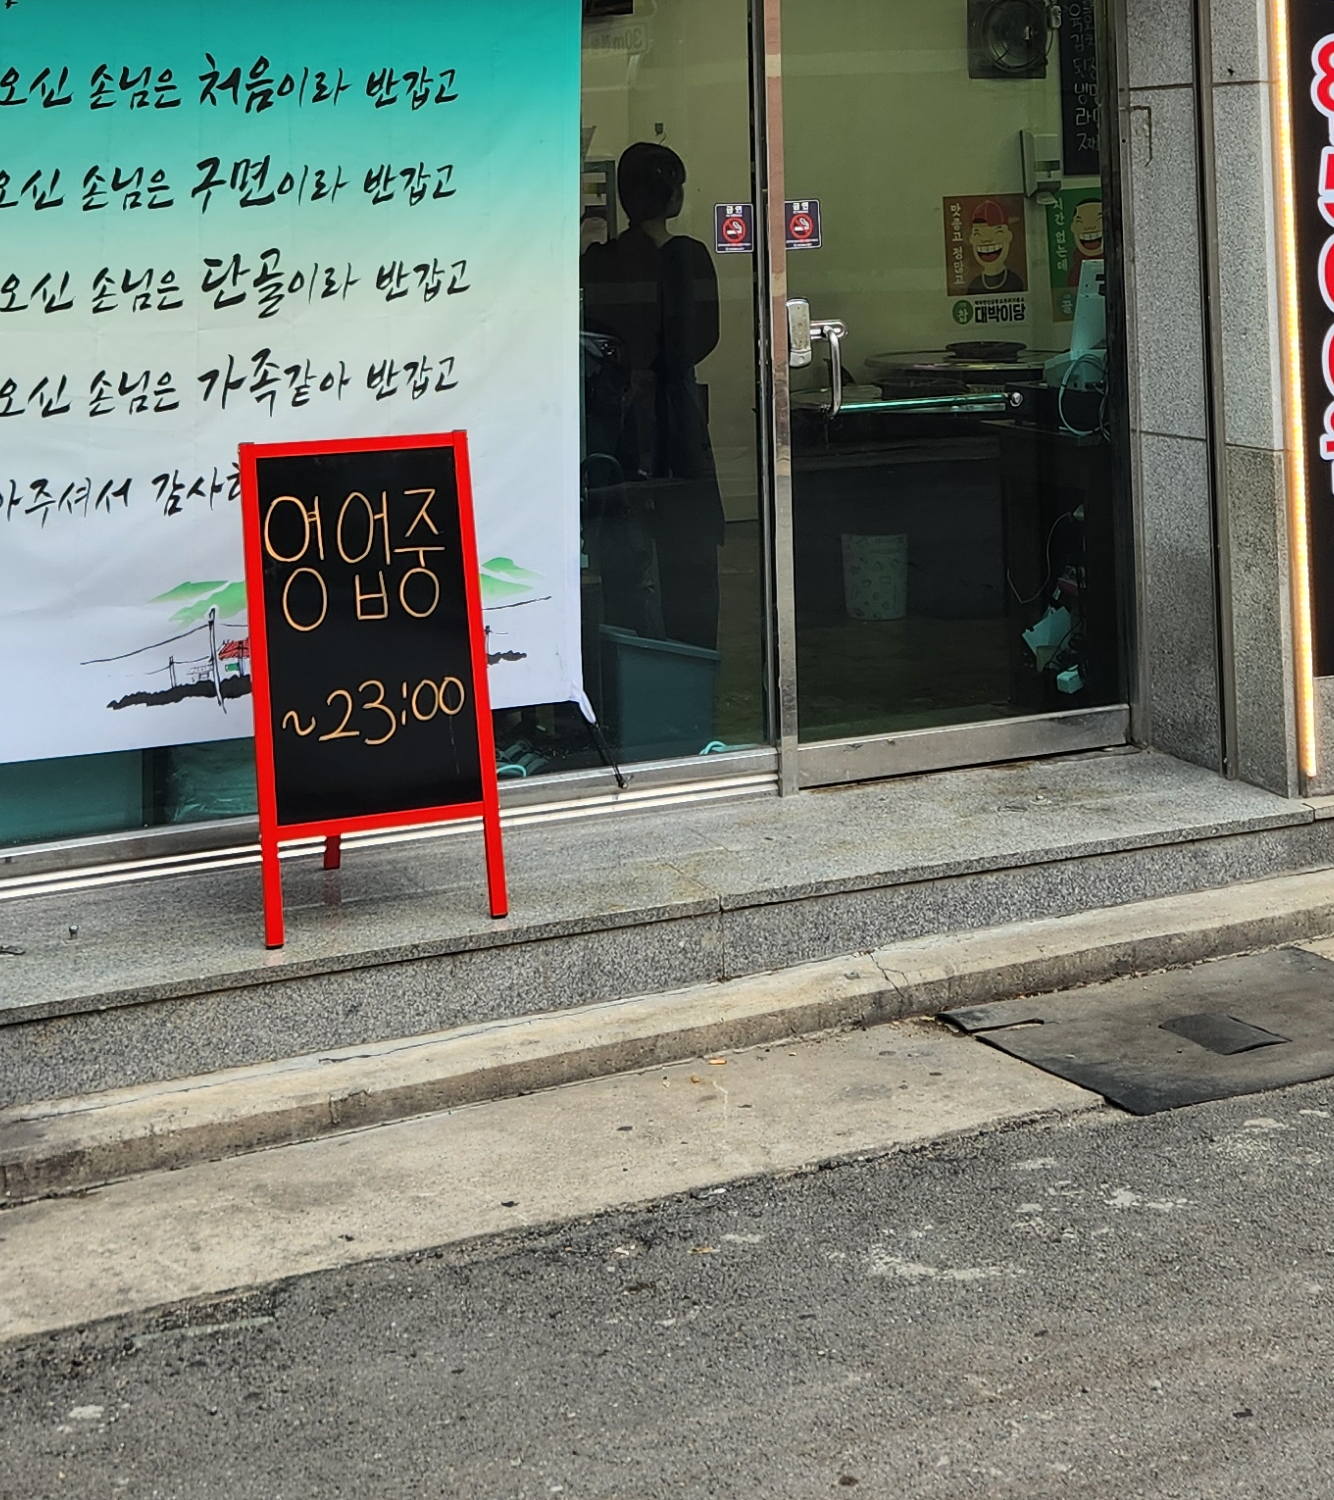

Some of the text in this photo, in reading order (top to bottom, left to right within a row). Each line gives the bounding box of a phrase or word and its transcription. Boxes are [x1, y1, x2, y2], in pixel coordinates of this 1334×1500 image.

[90, 64, 181, 109] 손님은
[199, 53, 350, 113] 처음이라
[366, 71, 458, 110] 반갑고
[83, 167, 173, 211] 손님은
[191, 155, 348, 213] 구면이라
[364, 162, 456, 206] 반갑고
[0, 271, 73, 313] 오신
[92, 268, 183, 313] 손님은
[202, 248, 358, 318] 단골이라
[376, 258, 470, 302] 반갑고
[975, 304, 1025, 323] 대박이당
[90, 370, 179, 417] 손님은
[198, 348, 350, 416] 가족같아
[367, 357, 458, 398] 반갑고
[262, 489, 444, 634] 영업중
